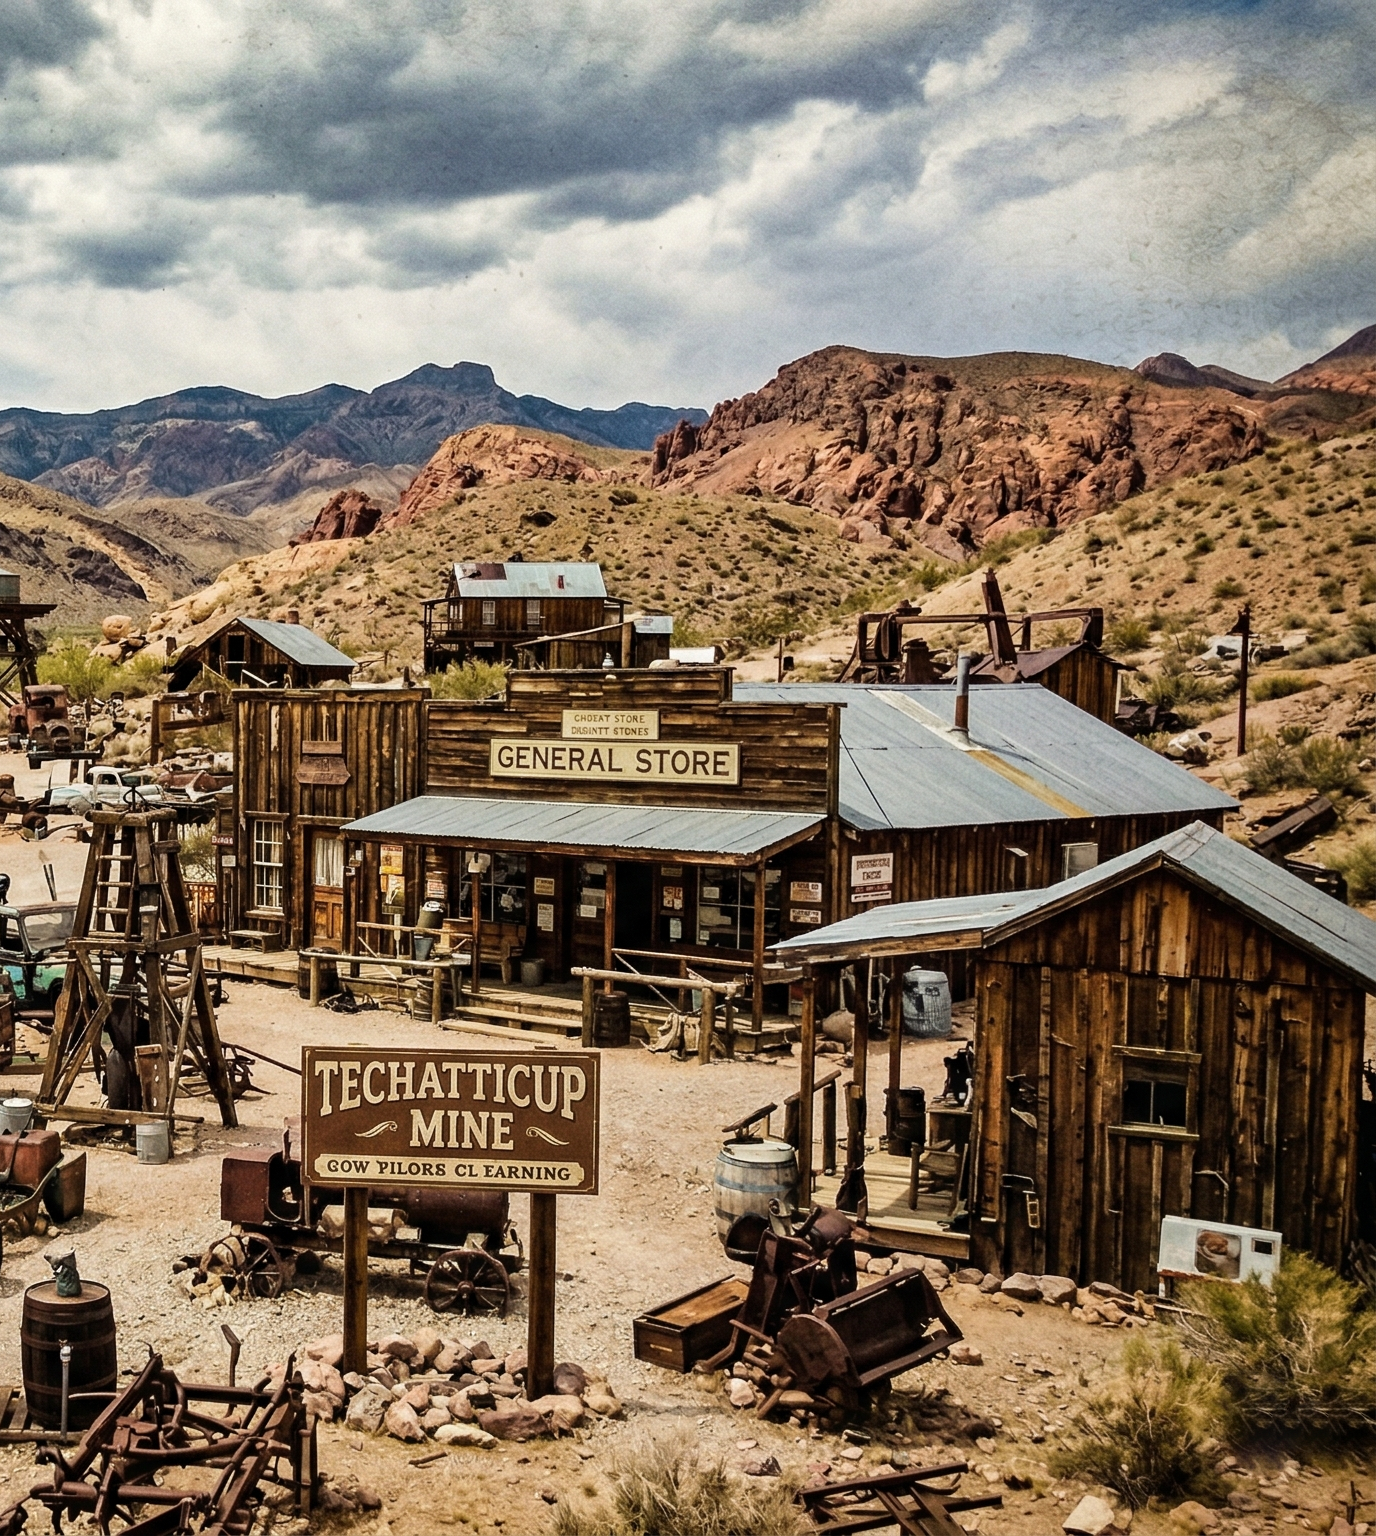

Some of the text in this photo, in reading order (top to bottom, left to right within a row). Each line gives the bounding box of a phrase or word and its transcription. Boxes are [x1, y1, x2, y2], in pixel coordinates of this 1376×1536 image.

[614, 714, 646, 724] STORE
[497, 745, 730, 777] GENERAL STORE
[314, 1060, 587, 1121] TECHATTICUP
[409, 1108, 514, 1151] MINE
[376, 1160, 446, 1176] PILORS
